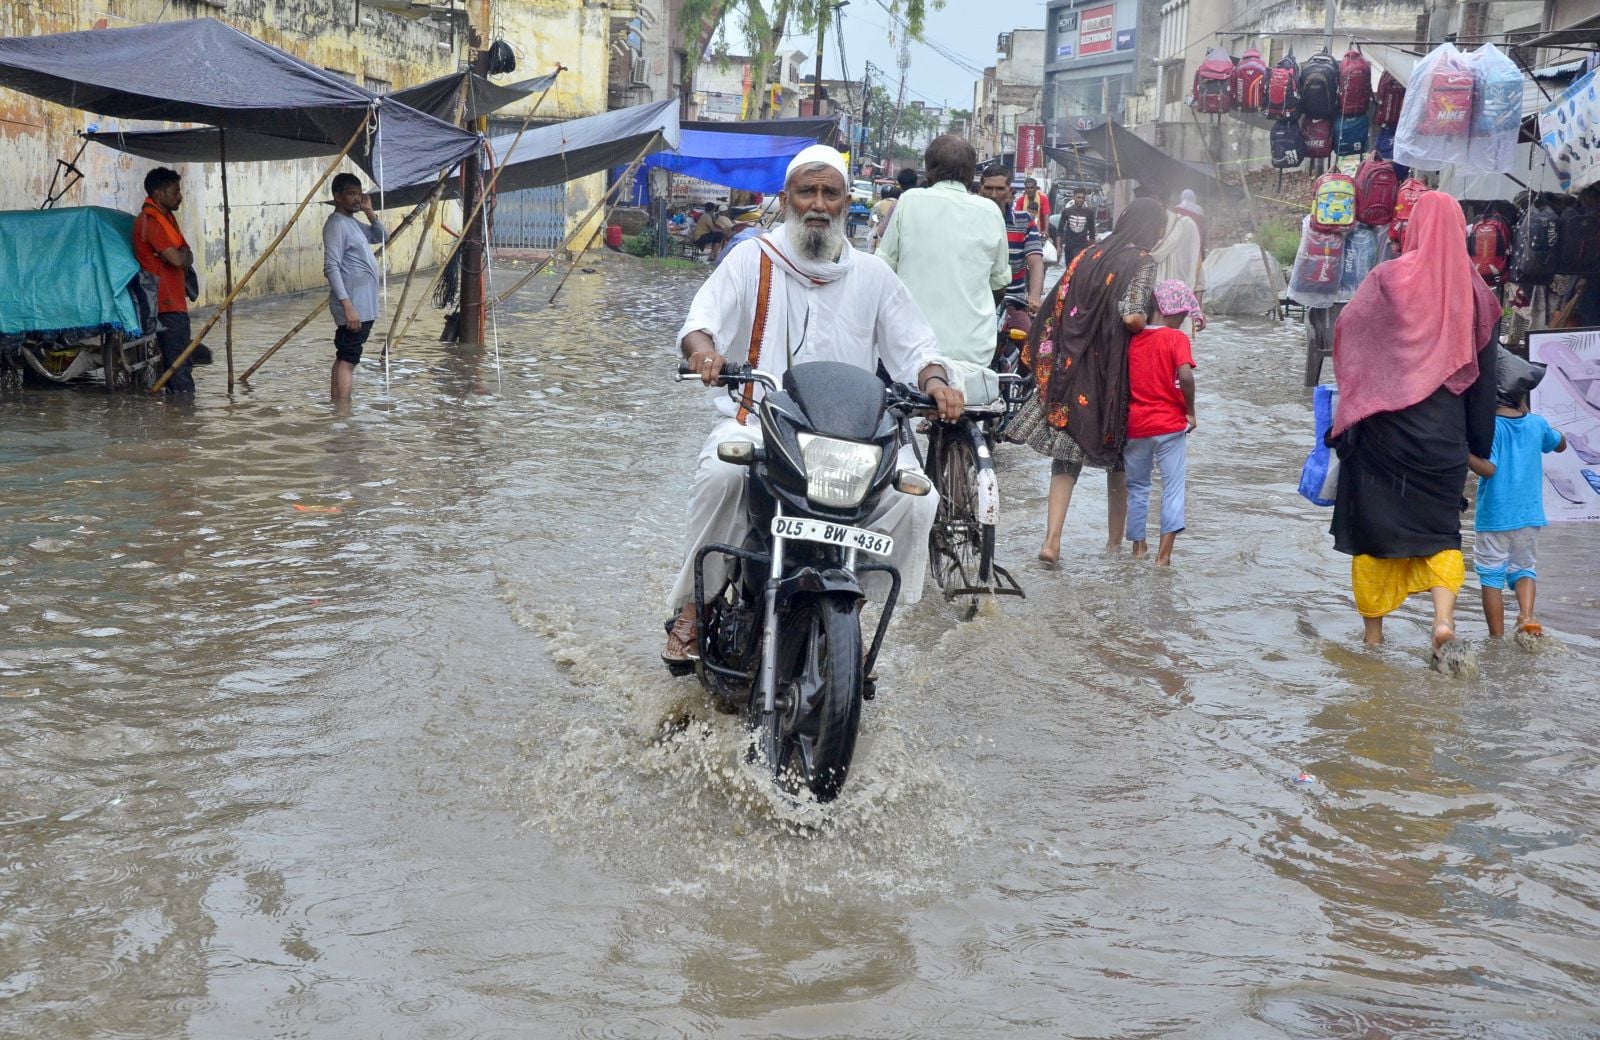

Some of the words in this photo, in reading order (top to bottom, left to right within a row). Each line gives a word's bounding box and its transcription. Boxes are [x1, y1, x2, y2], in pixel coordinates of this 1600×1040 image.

[1058, 17, 1075, 27] SONY
[1080, 30, 1112, 45] ELECTRONICS
[1437, 110, 1467, 120] NIKE
[1305, 139, 1325, 148] NIKE
[1345, 248, 1355, 273] safari
[775, 519, 804, 536] DL5
[824, 525, 848, 542] BW
[858, 534, 891, 554] 4361
